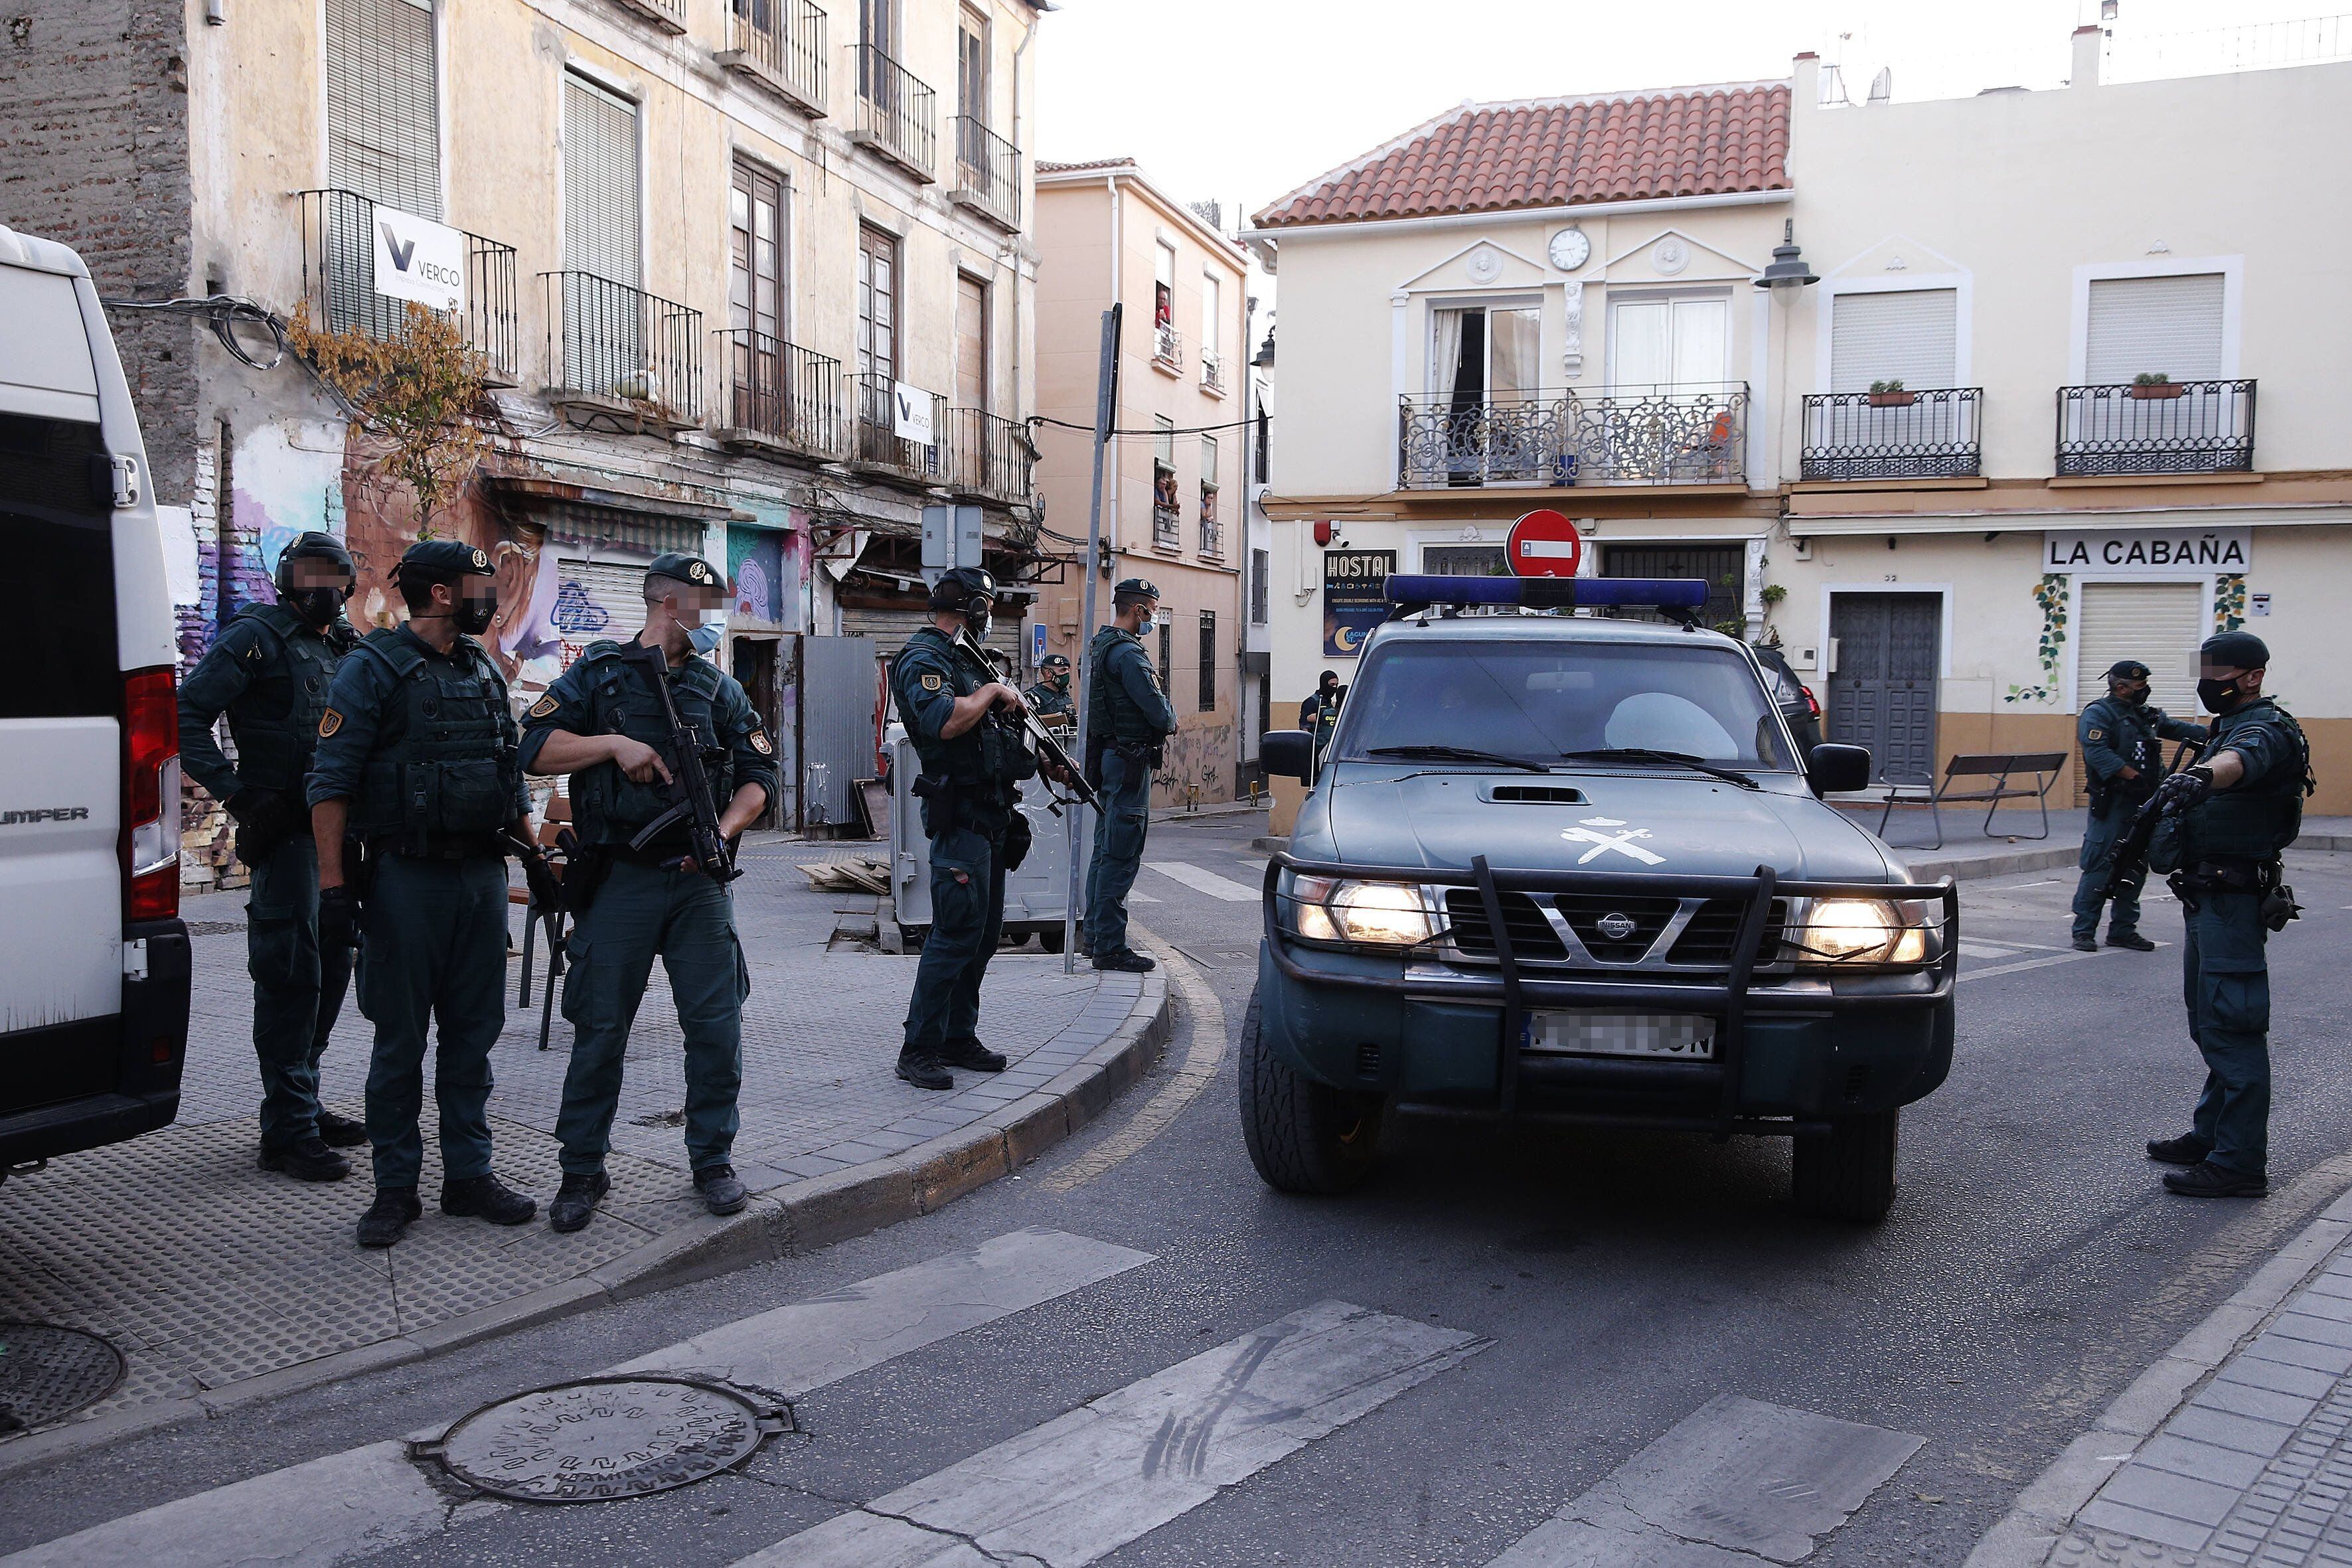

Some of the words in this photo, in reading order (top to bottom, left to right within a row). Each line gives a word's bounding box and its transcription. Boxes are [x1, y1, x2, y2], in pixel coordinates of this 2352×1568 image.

[418, 260, 460, 287] VERCO
[911, 413, 929, 429] VERCO
[2050, 540, 2090, 565] LA
[2103, 534, 2244, 565] CABAÑA
[1327, 556, 1391, 577] HOSTAL
[1602, 920, 1632, 929] NISSAN
